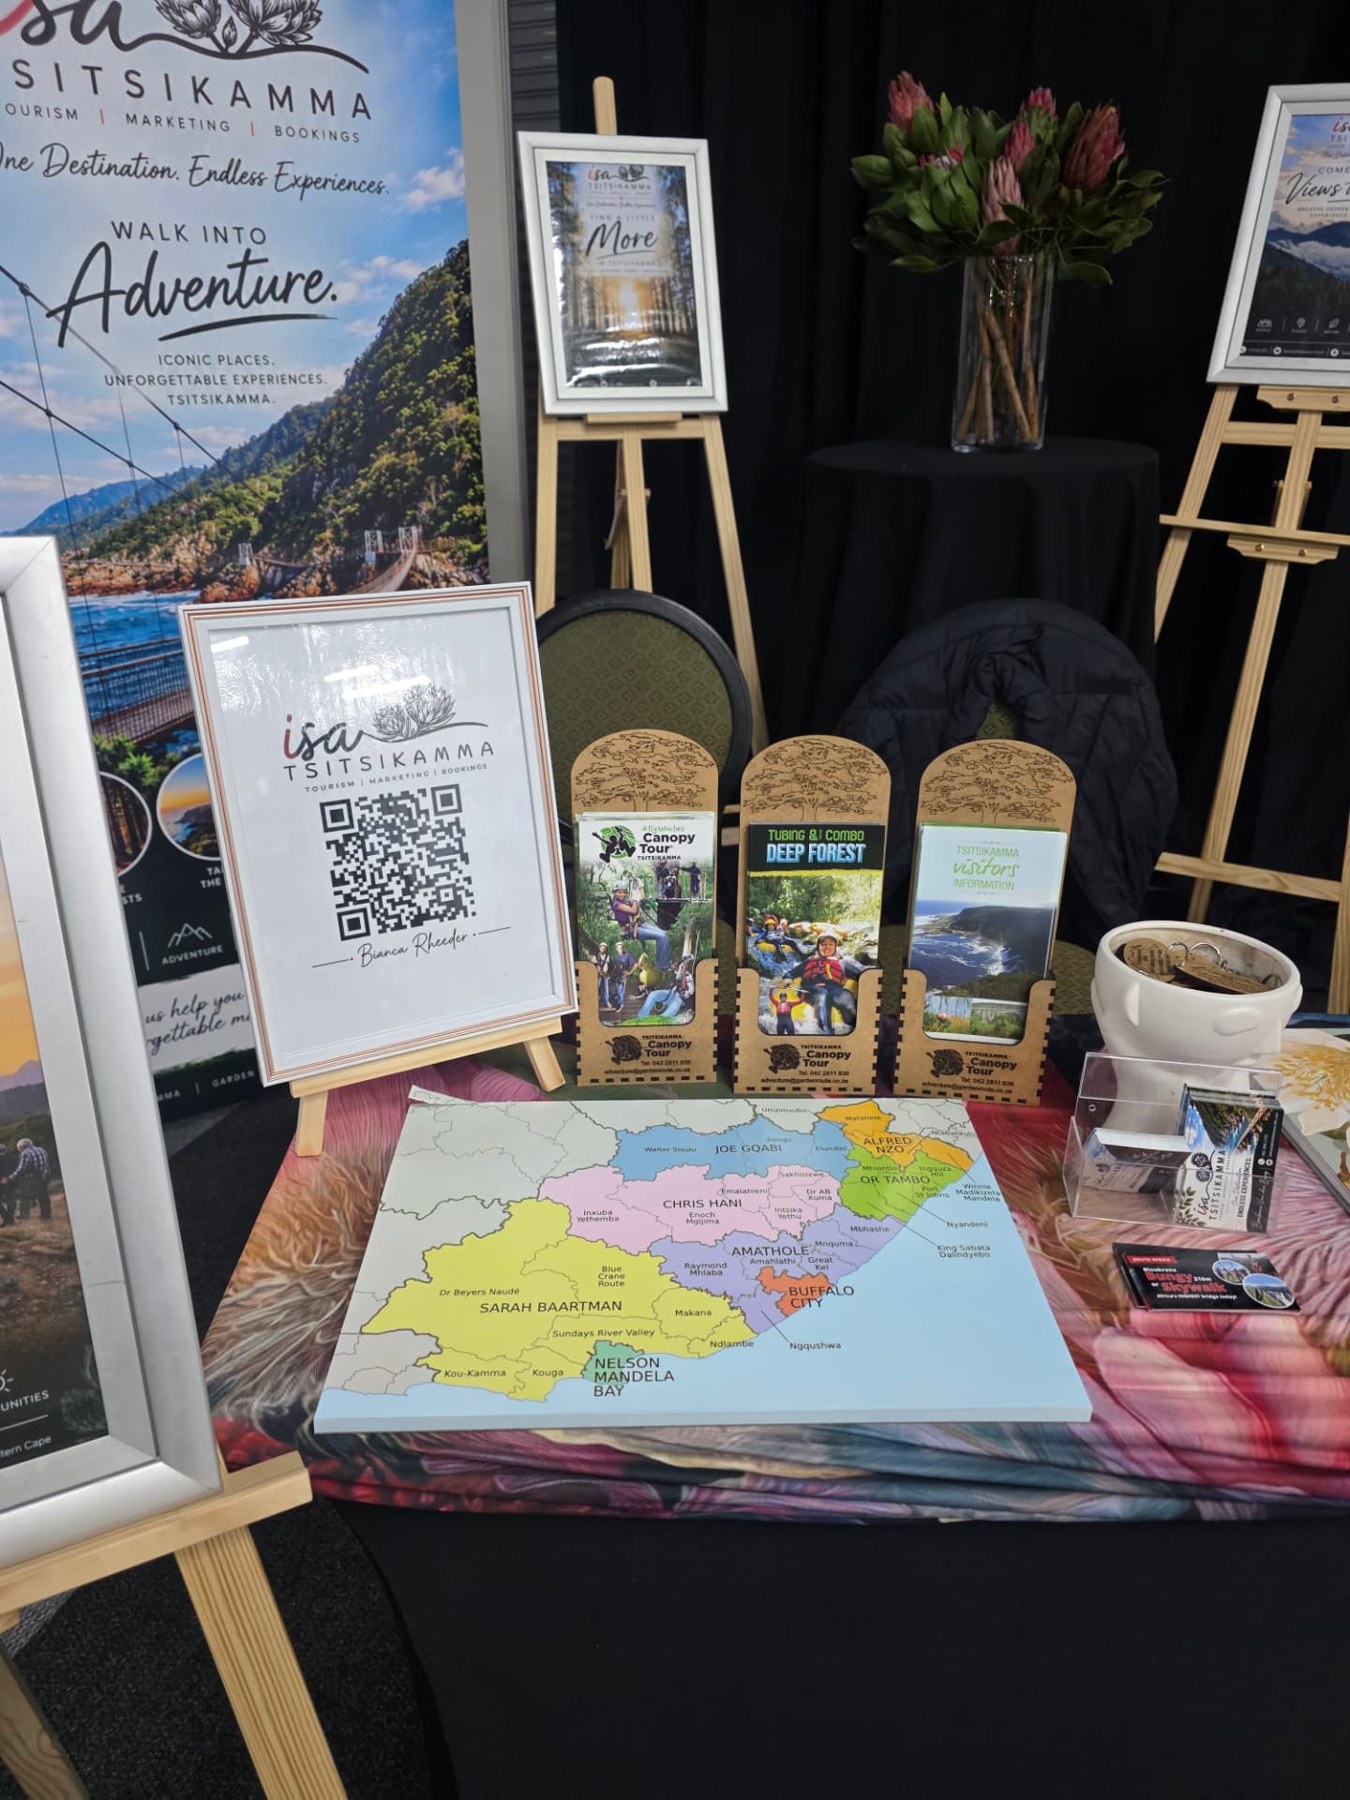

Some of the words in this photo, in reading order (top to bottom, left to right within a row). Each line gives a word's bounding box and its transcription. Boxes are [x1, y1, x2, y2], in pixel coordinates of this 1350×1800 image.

[0, 0, 136, 51] sa
[12, 58, 373, 120] SITSIKAMMA
[5, 103, 78, 120] OURISM
[126, 113, 230, 132] MARKETING
[274, 125, 360, 143] BOOKINGS
[1332, 116, 1350, 132] is
[0, 140, 34, 172] ne
[40, 142, 180, 181] Destination.
[189, 154, 268, 188] Endless
[274, 160, 390, 202] Experiences.
[1285, 171, 1343, 205] Views
[110, 220, 189, 242] WALK
[203, 225, 267, 245] INTO
[585, 220, 659, 257] More
[45, 240, 338, 348] Adventure.
[158, 354, 212, 367] ICONIC
[218, 354, 275, 367] PLACES.
[105, 374, 228, 387] UNFORGETTABLE
[233, 373, 328, 386] EXPERIENCES.
[167, 394, 275, 406] TSITSIKAMMA.
[283, 714, 365, 762] isa
[283, 741, 494, 781] TSITSIKAMMA
[305, 781, 355, 793] TOURISM
[369, 770, 430, 784] MARKETING
[441, 763, 488, 775] BOOKINGS
[643, 832, 696, 845] Canopy
[809, 829, 818, 841] &
[639, 844, 670, 853] Tour
[766, 843, 806, 863] DEEP
[808, 843, 867, 863] FOREST
[956, 845, 1020, 858] TSITSIKAMMA
[952, 857, 1020, 877] visitors
[200, 877, 222, 889] THE
[953, 878, 1015, 891] INFORMATION
[357, 942, 408, 967] Bianca
[412, 928, 468, 957] Rheeder
[162, 944, 223, 965] ADVENTURE
[145, 1011, 165, 1024] us
[170, 993, 209, 1021] help
[213, 992, 246, 1013] you
[648, 1040, 692, 1049] Canopy
[644, 1049, 671, 1057] Tour
[806, 1050, 851, 1060] Canopy
[802, 1059, 830, 1067] Tour
[970, 1058, 1018, 1070] Canopy
[966, 1066, 994, 1076] Tour
[212, 1070, 255, 1087] GARDEN
[863, 1137, 912, 1146] ALFRED
[715, 1145, 737, 1154] JOE
[741, 1144, 782, 1153] GQABI
[876, 1146, 904, 1154] NZO
[860, 1175, 879, 1184] OR
[885, 1175, 930, 1184] TAMBO
[1209, 1150, 1226, 1220] TSITSIKAMMA
[663, 1200, 705, 1209] CHRIS
[709, 1199, 742, 1208] HANI
[1237, 1193, 1247, 1218] ENDLESS
[946, 1221, 988, 1229] Nyandeni
[815, 1240, 854, 1248] Mnquma
[937, 1244, 957, 1252] King
[731, 1246, 810, 1257] AMATHOLE
[939, 1251, 991, 1259] Dalindyebo
[601, 1265, 622, 1273] Blue
[684, 1262, 727, 1270] Raymond
[598, 1272, 625, 1280] Crane
[453, 1288, 487, 1297] Beyers
[489, 1287, 520, 1296] Naudé
[789, 1285, 855, 1296] BUFFALO
[479, 1302, 532, 1313] SARAH
[537, 1301, 622, 1313] BAARTMAN
[790, 1298, 823, 1308] CITY
[552, 1330, 594, 1338] Sundays
[597, 1329, 623, 1337] River
[626, 1328, 655, 1337] Valley
[709, 1340, 754, 1348] Ndlambe
[789, 1342, 842, 1350] Ngqushwa
[594, 1357, 660, 1369] NELSON
[444, 1369, 506, 1378] Kou-Kamma
[532, 1369, 564, 1378] Kouga
[594, 1370, 675, 1382] MANDELA
[593, 1385, 625, 1397] BAY
[1, 1389, 50, 1411] UNITIES
[0, 1445, 22, 1458] tern
[24, 1436, 52, 1450] Cape
